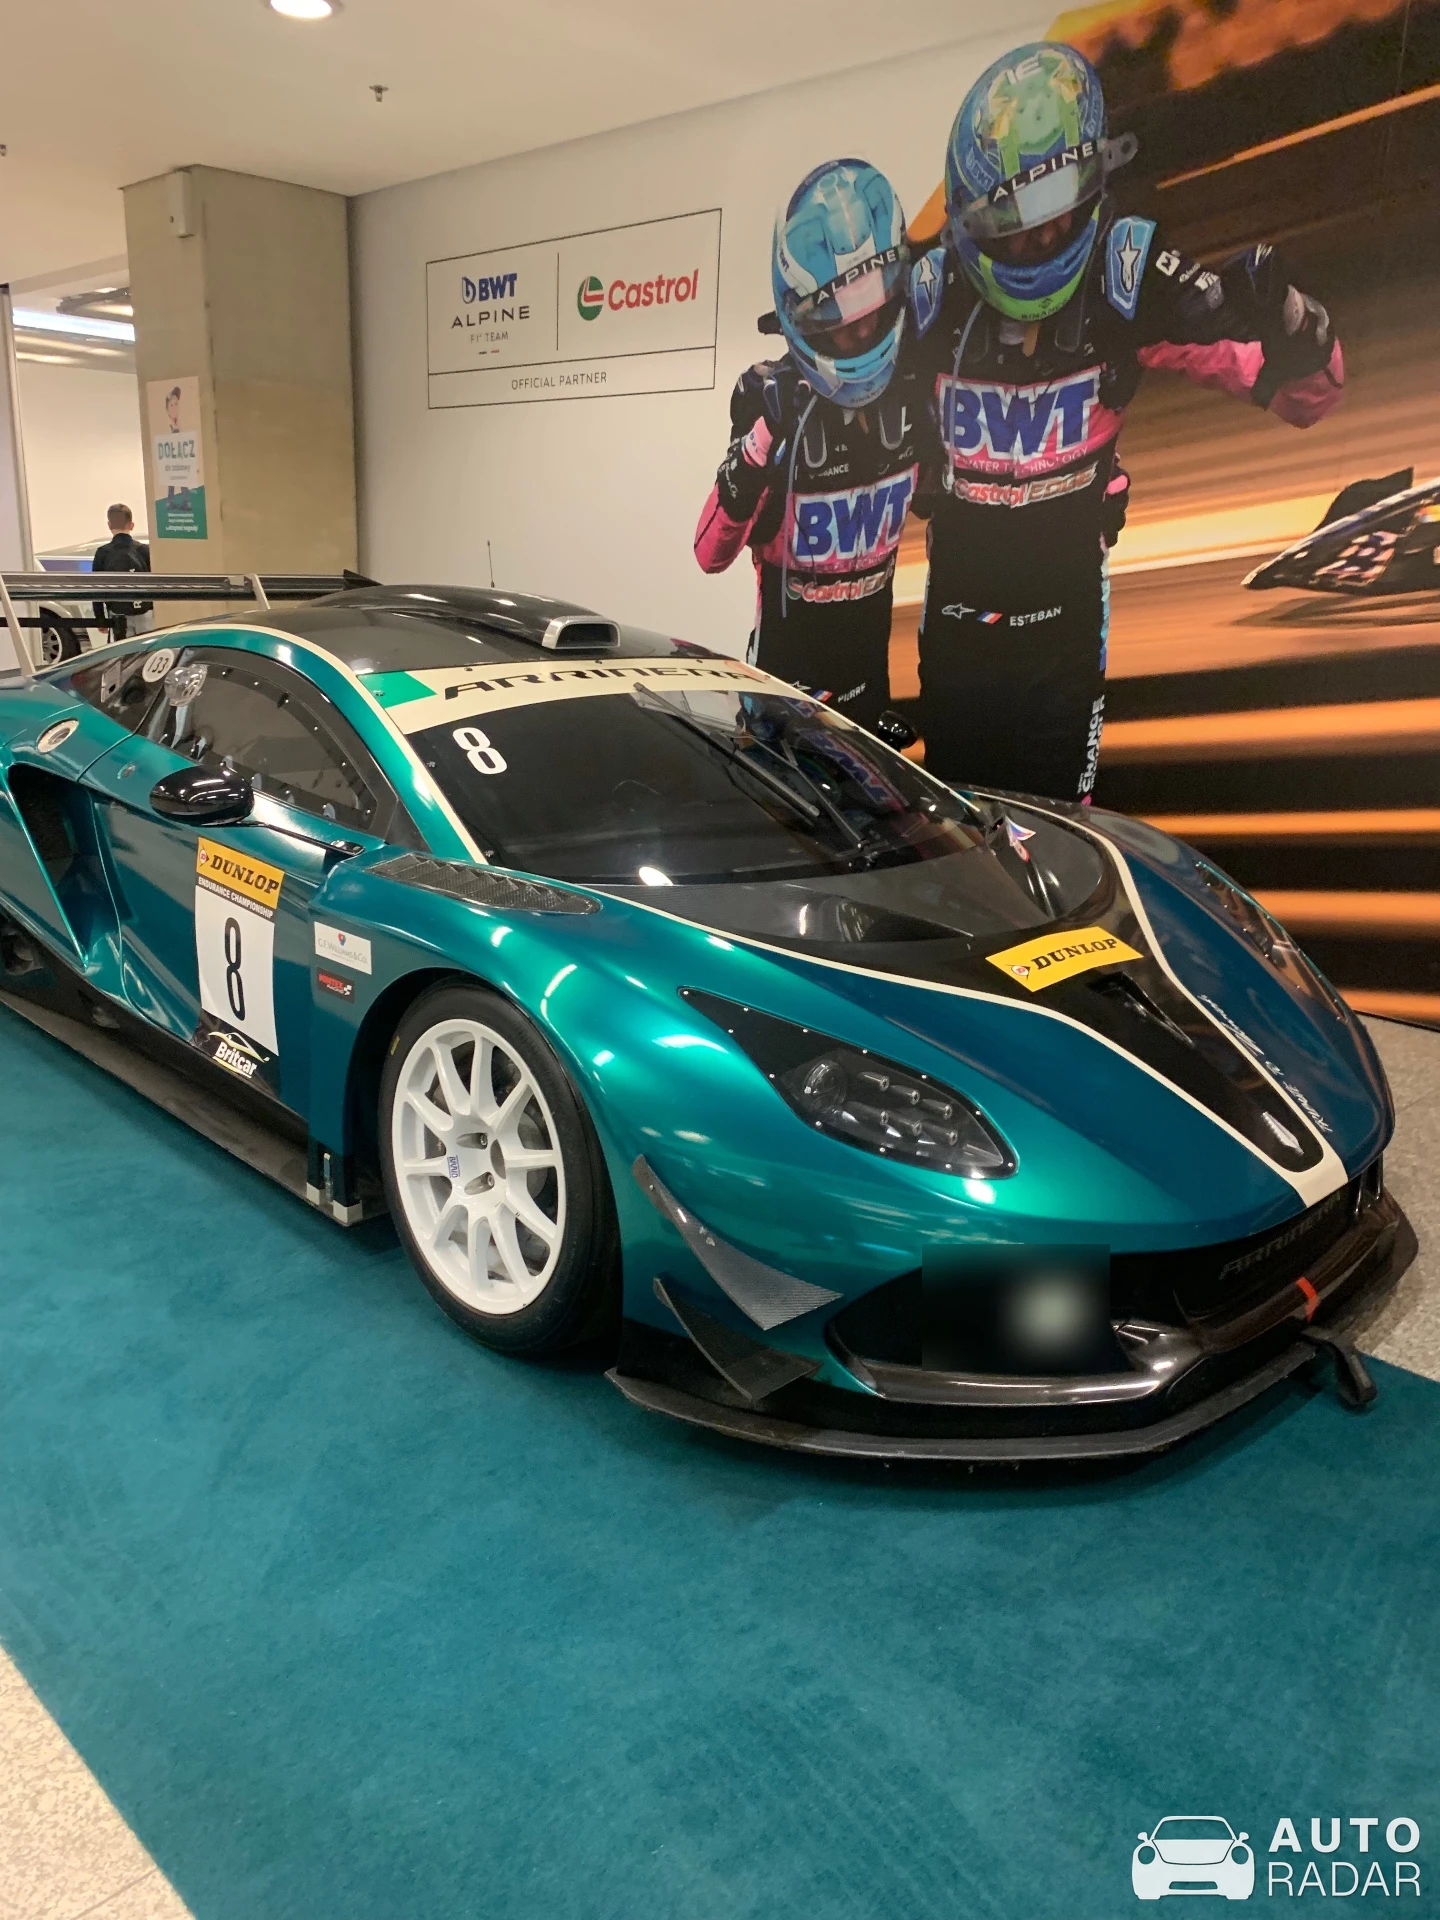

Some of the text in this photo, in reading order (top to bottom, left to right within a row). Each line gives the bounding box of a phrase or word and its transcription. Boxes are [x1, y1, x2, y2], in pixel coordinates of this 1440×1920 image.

[993, 141, 1094, 202] ALPINE
[478, 272, 518, 301] BWT
[608, 268, 699, 311] Castrol
[816, 249, 898, 304] ALPINE
[451, 305, 530, 329] ALPINE
[485, 331, 509, 343] TEAM
[511, 371, 608, 391] OFFICIAL PARTNER
[943, 377, 1096, 457] BWT
[954, 478, 1028, 507] Castrol
[795, 475, 912, 557] BWT
[1009, 605, 1062, 627] ESTEBAN
[444, 667, 767, 700] ARRINERA
[451, 726, 509, 775] 8
[210, 854, 280, 894] DUNLOP
[198, 876, 274, 919] ENDURANCE CHAMPIONSHIP
[224, 917, 246, 1022] 8
[1031, 938, 1118, 970] DUNLOP
[214, 1041, 258, 1076] Britcar
